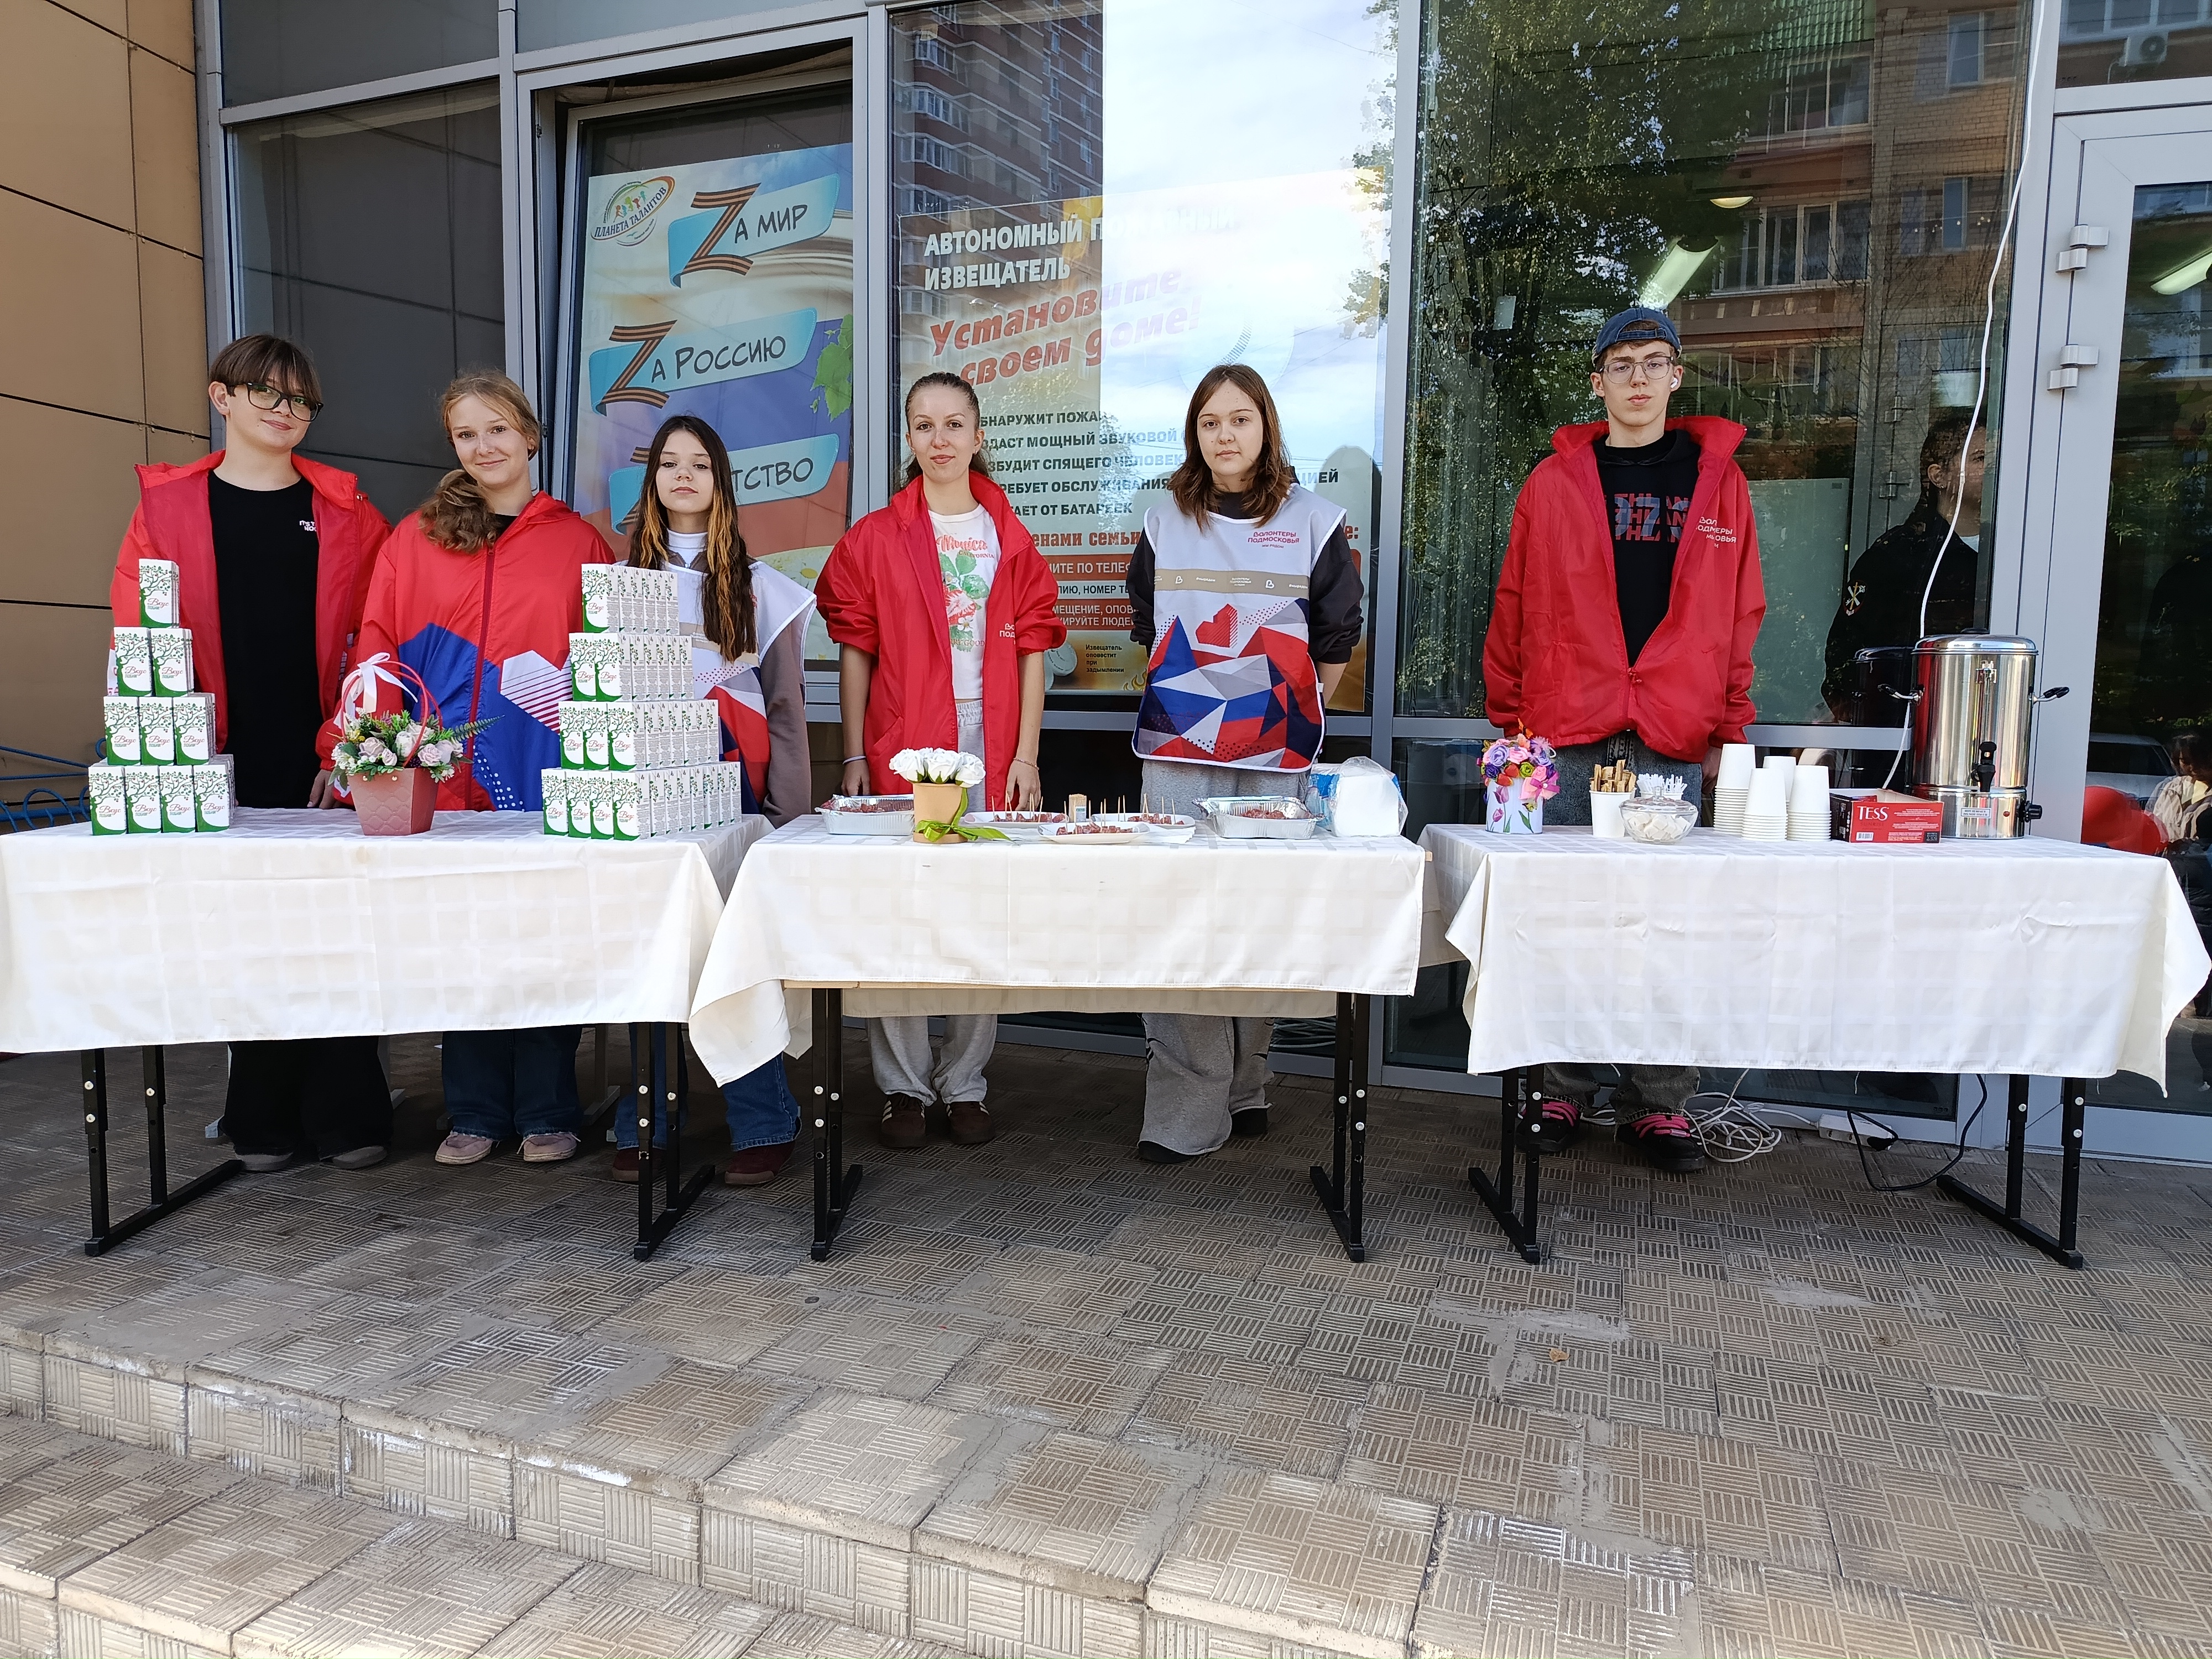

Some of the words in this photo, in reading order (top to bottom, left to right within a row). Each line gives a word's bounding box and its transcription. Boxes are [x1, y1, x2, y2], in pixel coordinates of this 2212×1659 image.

[594, 220, 629, 237] ПЛАНЕТА
[629, 187, 667, 226] ТАЛАНТОВ
[758, 205, 807, 237] МИР
[924, 214, 1082, 257] АВТОНОМНЫЙ
[924, 257, 1071, 291] ИЗВЕЩАТЕЛЬ
[930, 268, 1182, 357] Установите
[960, 336, 1072, 388] своем
[980, 413, 1053, 427] БНАРУЖИТ
[984, 437, 1024, 451] ОДАСТ
[1027, 432, 1095, 448] МОЩНЫЙ
[1099, 429, 1177, 444] ЗВУКОВОЙ
[988, 459, 1040, 473] ЗБУДИТ
[1042, 457, 1112, 471] СПЯЩЕГО
[1115, 454, 1182, 467] ЧЕЛОВЕК
[731, 458, 814, 493] ТСТВО
[1000, 482, 1048, 494] РЕБУЕТ
[1041, 505, 1058, 515] ОТ
[1061, 503, 1133, 515] БАТАРЕЕК
[1032, 533, 1082, 547] енами
[1089, 531, 1141, 546] семьи
[958, 550, 994, 559] CALIFORNIA
[1077, 563, 1093, 573] ПО
[1083, 585, 1117, 594] НОМЕР
[1052, 605, 1103, 615] МЕЩЕНИЕ,
[1857, 806, 1888, 821] TESS
